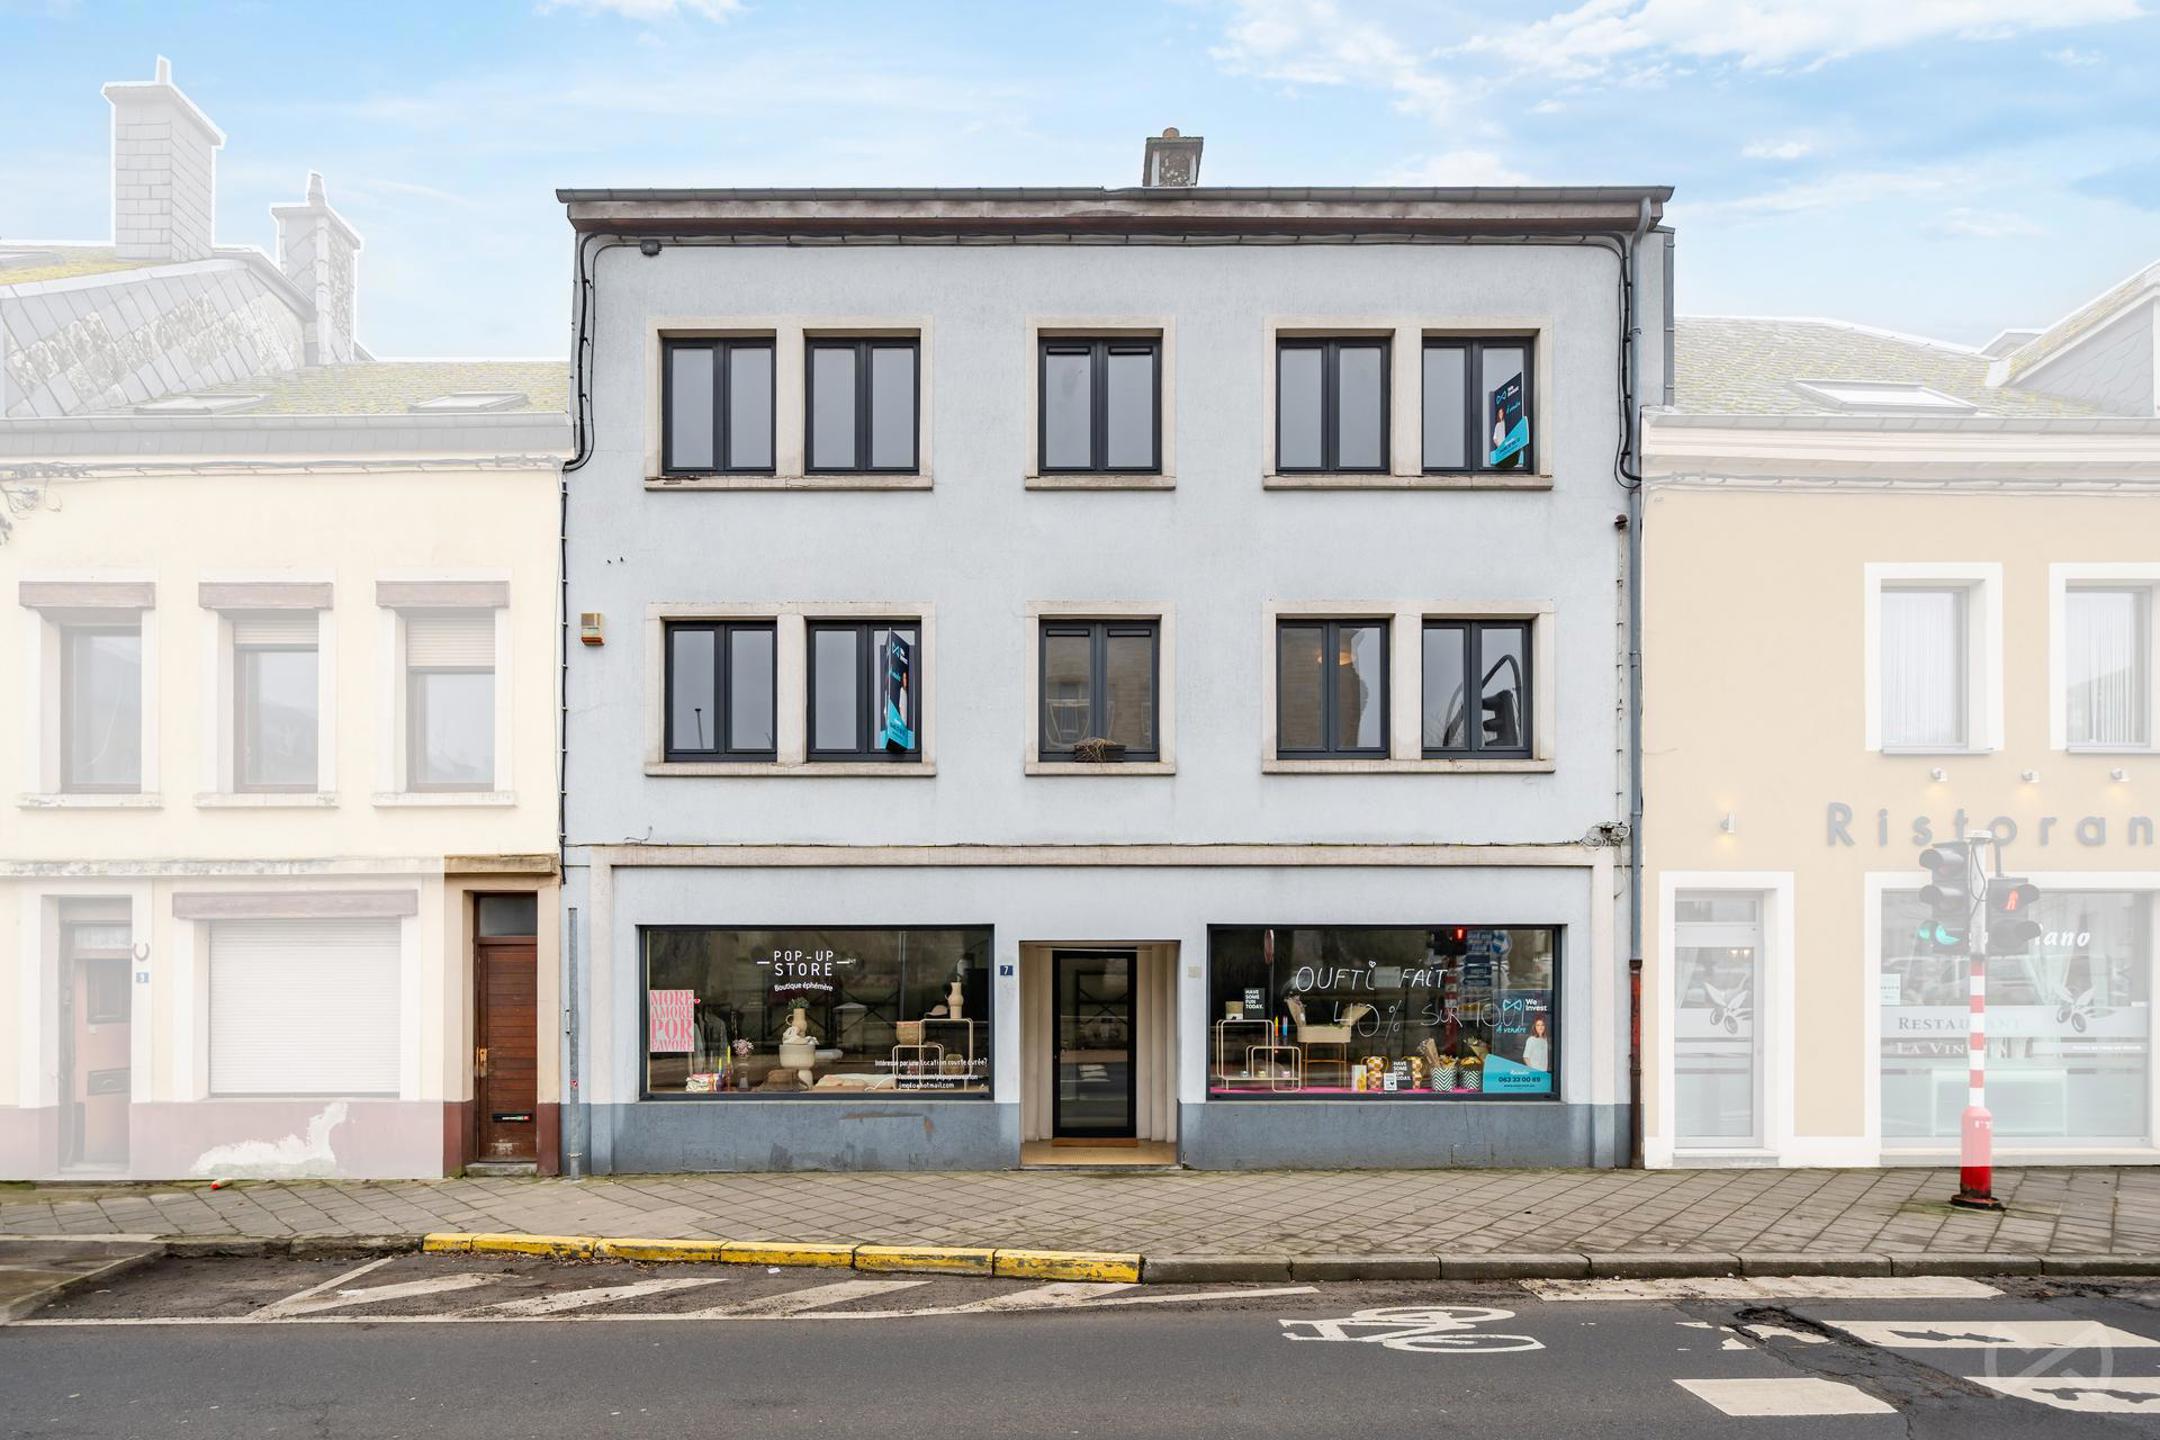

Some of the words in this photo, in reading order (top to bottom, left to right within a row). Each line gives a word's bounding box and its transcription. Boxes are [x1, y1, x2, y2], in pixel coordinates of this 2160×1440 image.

[774, 950, 834, 961] POP-UP
[774, 962, 833, 976] STORE
[774, 983, 801, 992] Boutique
[802, 982, 834, 991] éphémère
[651, 990, 693, 1006] MORE
[1525, 998, 1538, 1006] We
[651, 1006, 693, 1018] AMORE
[651, 1018, 693, 1040] POR
